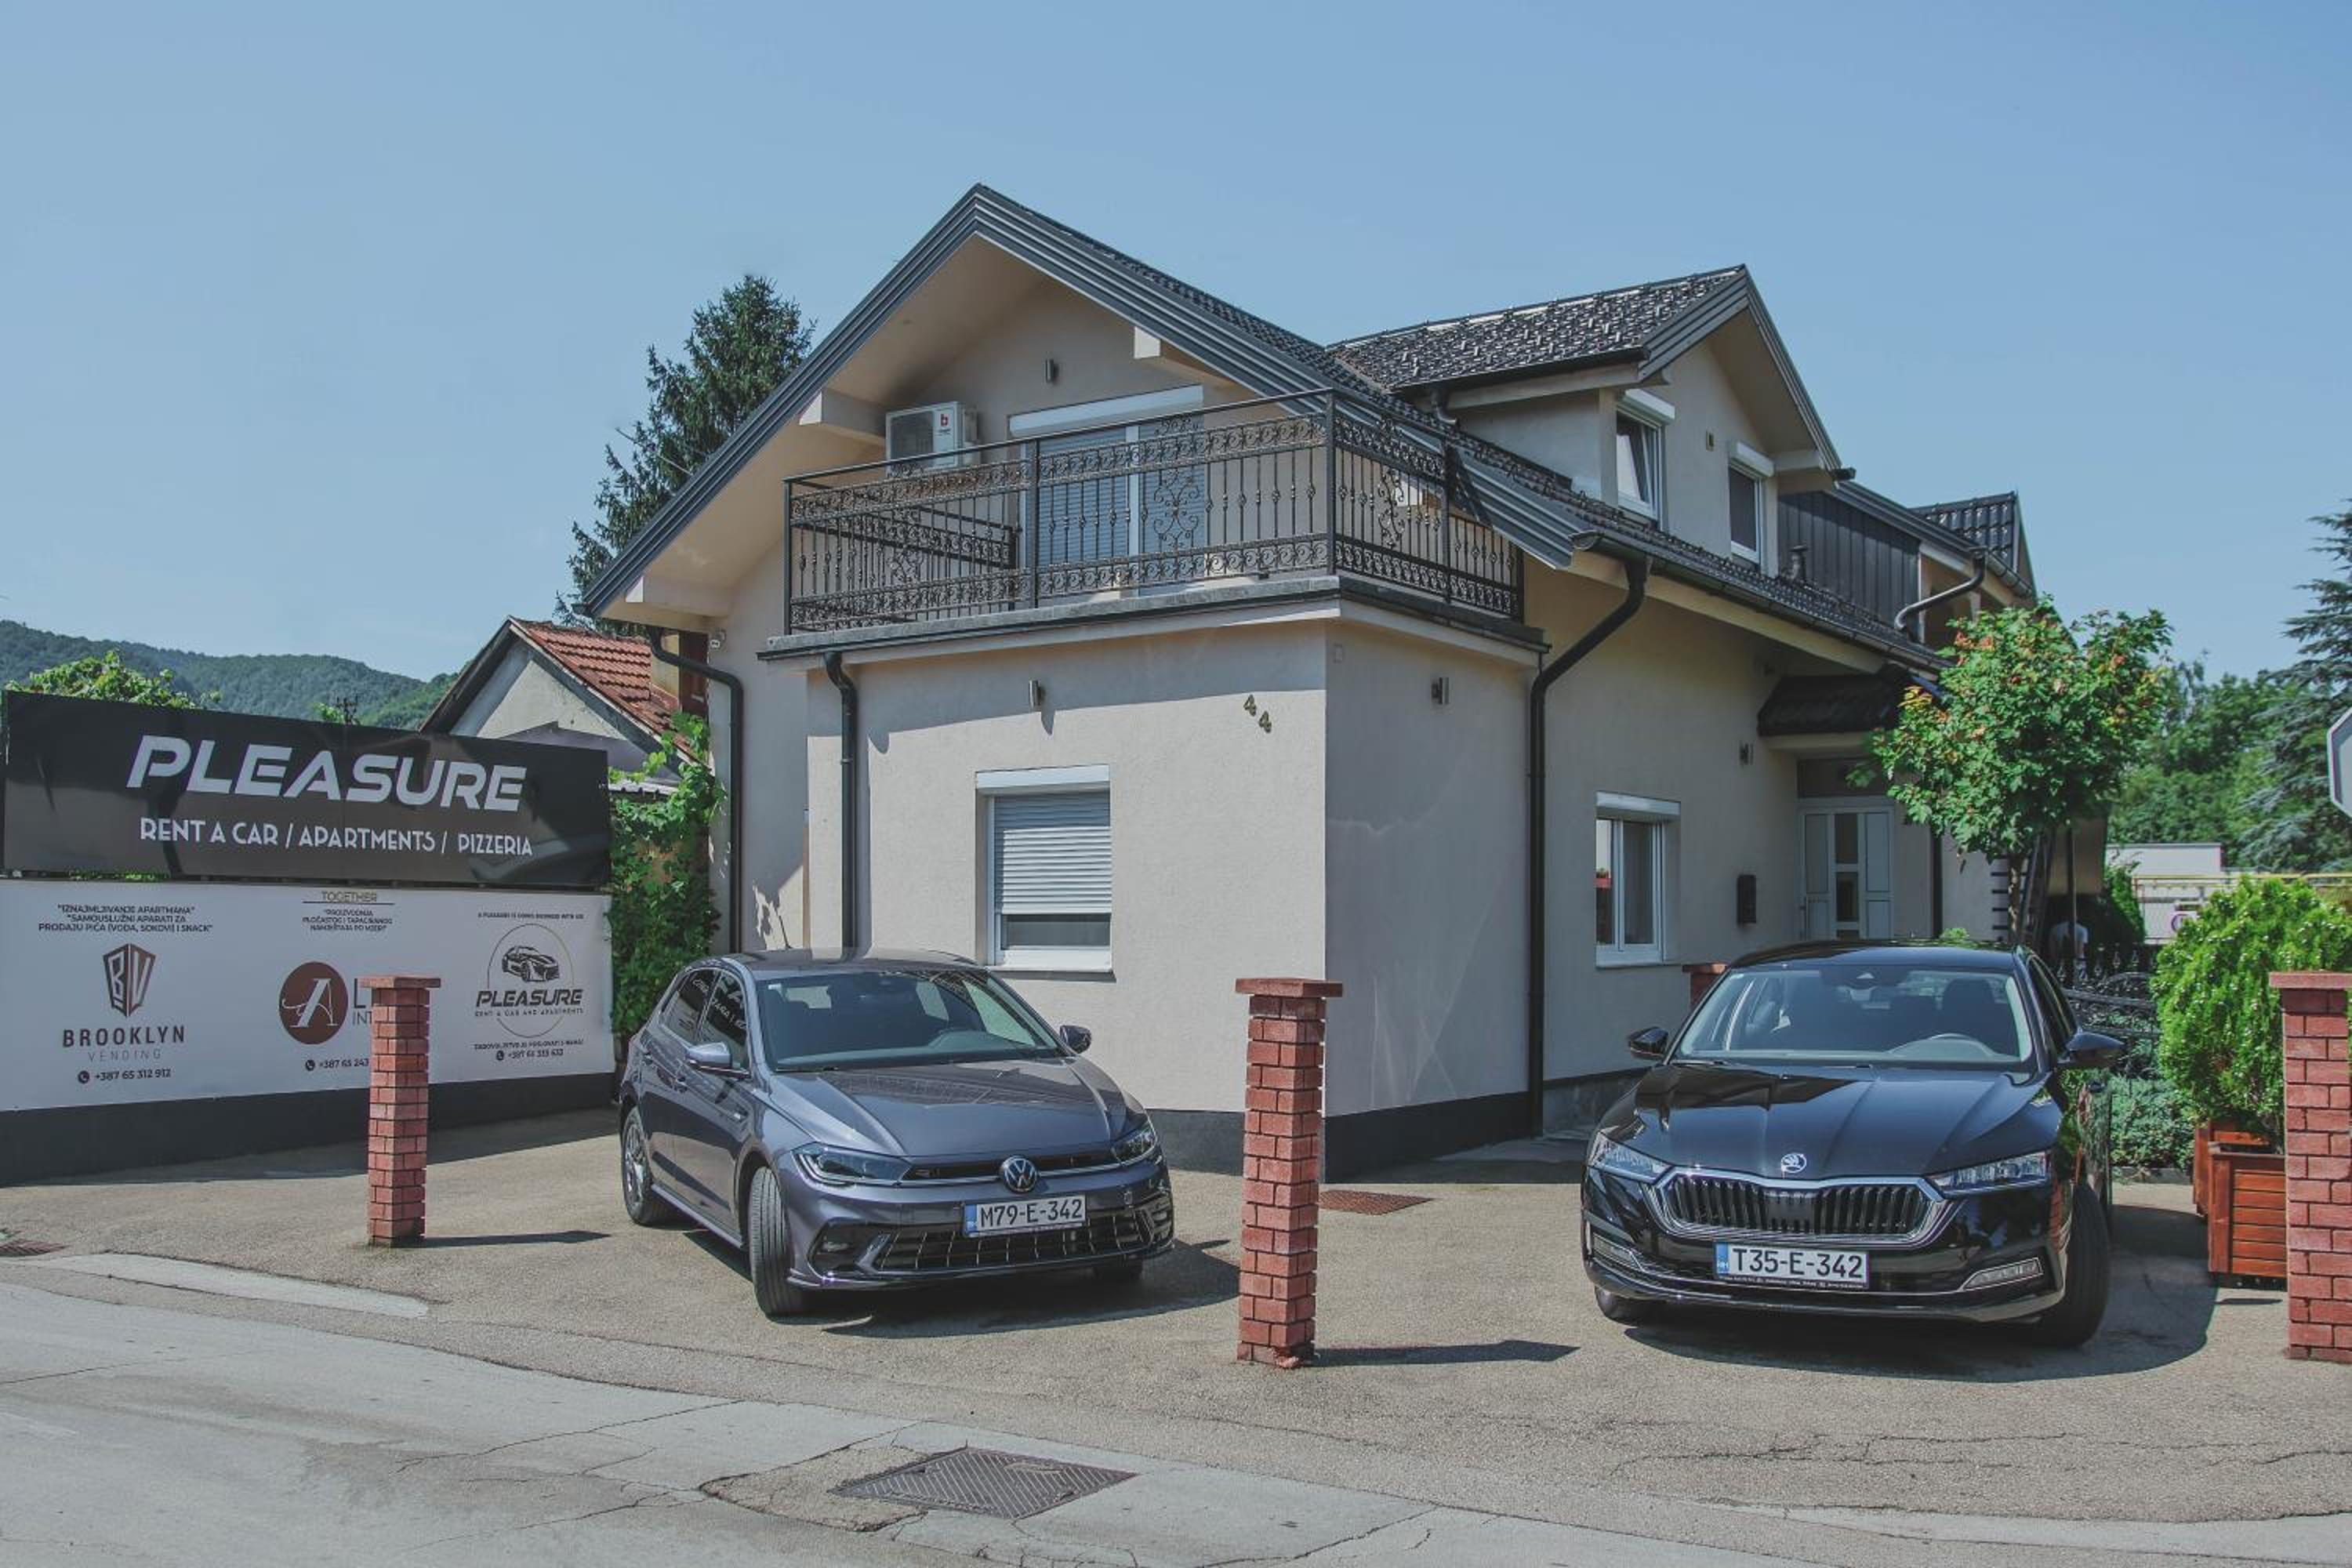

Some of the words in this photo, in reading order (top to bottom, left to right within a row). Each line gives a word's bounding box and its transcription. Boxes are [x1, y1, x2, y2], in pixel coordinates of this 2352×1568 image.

[125, 735, 528, 812] PLEASURE
[140, 817, 206, 842] RENT
[209, 822, 227, 844] A
[231, 822, 278, 846] CAR
[298, 825, 435, 852] APARTMENTS
[458, 832, 533, 856] PIZZERIA
[476, 989, 584, 1007] PLEASURE
[63, 1025, 185, 1048] BROOKLYN
[88, 1048, 162, 1062] VENDING
[94, 1070, 120, 1081] +387
[122, 1070, 135, 1080] 65
[981, 1199, 1083, 1228] M79-E-342
[1732, 1247, 1864, 1279] T35-E-342
